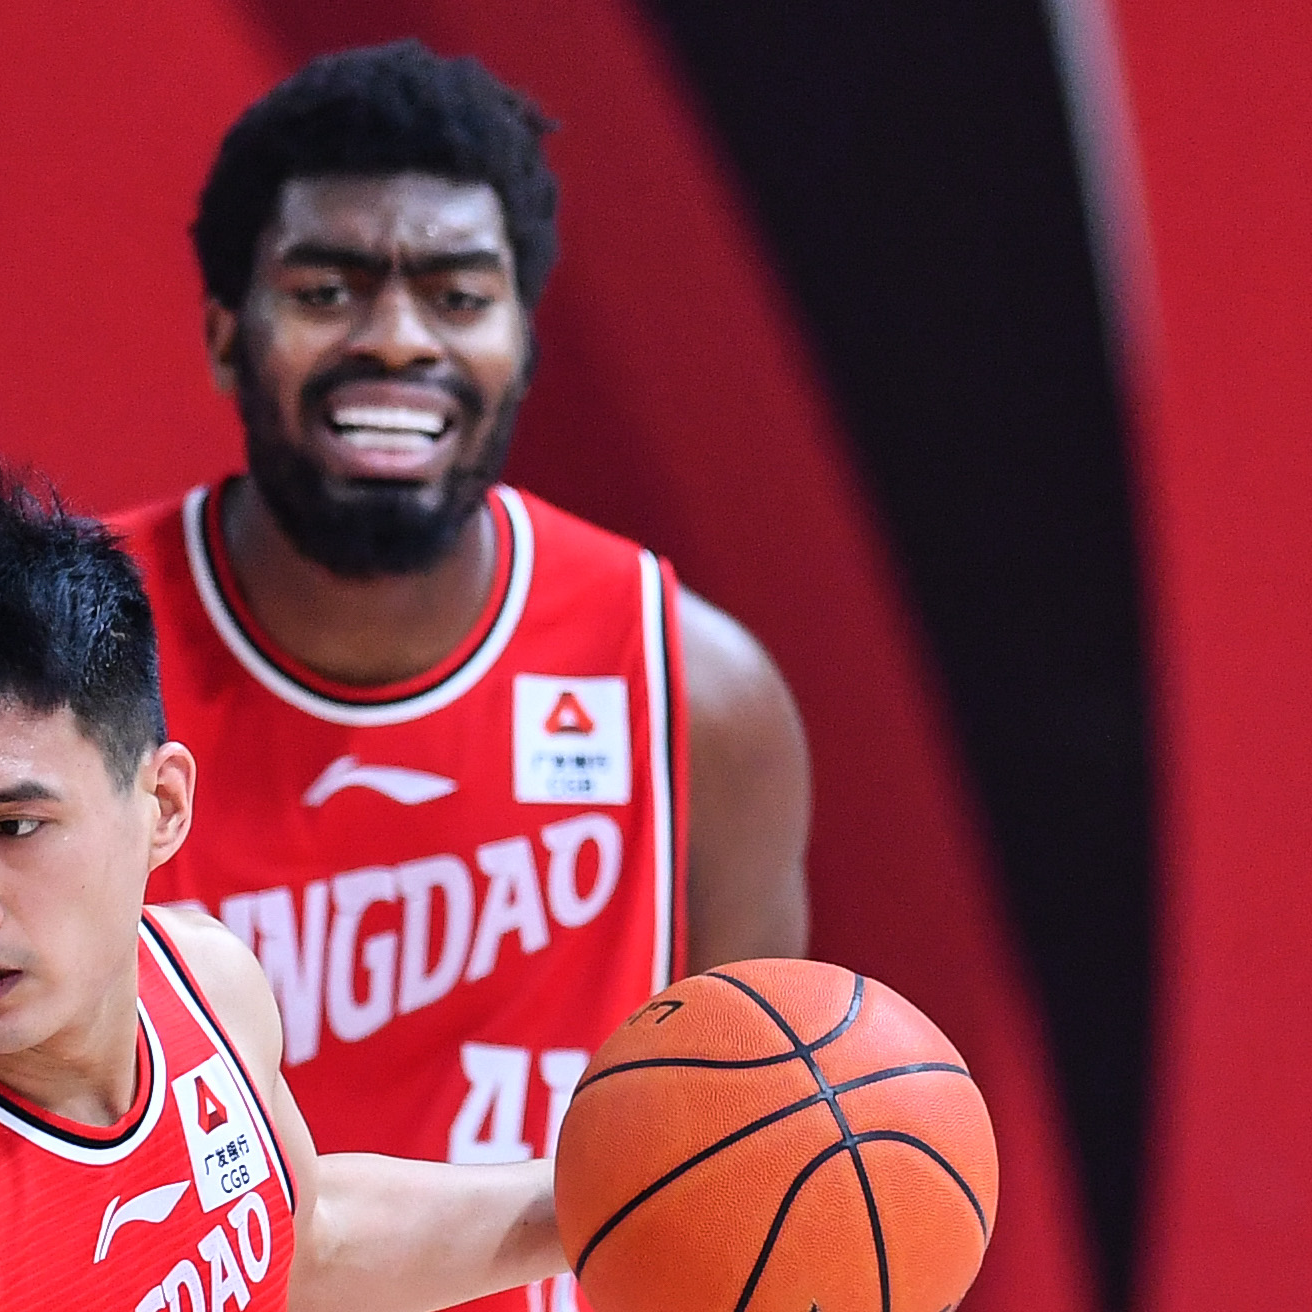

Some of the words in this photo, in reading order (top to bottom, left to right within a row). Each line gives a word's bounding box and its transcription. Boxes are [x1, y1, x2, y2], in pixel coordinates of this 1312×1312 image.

[204, 1134, 250, 1176] 广发银行
[221, 1164, 250, 1194] CGB
